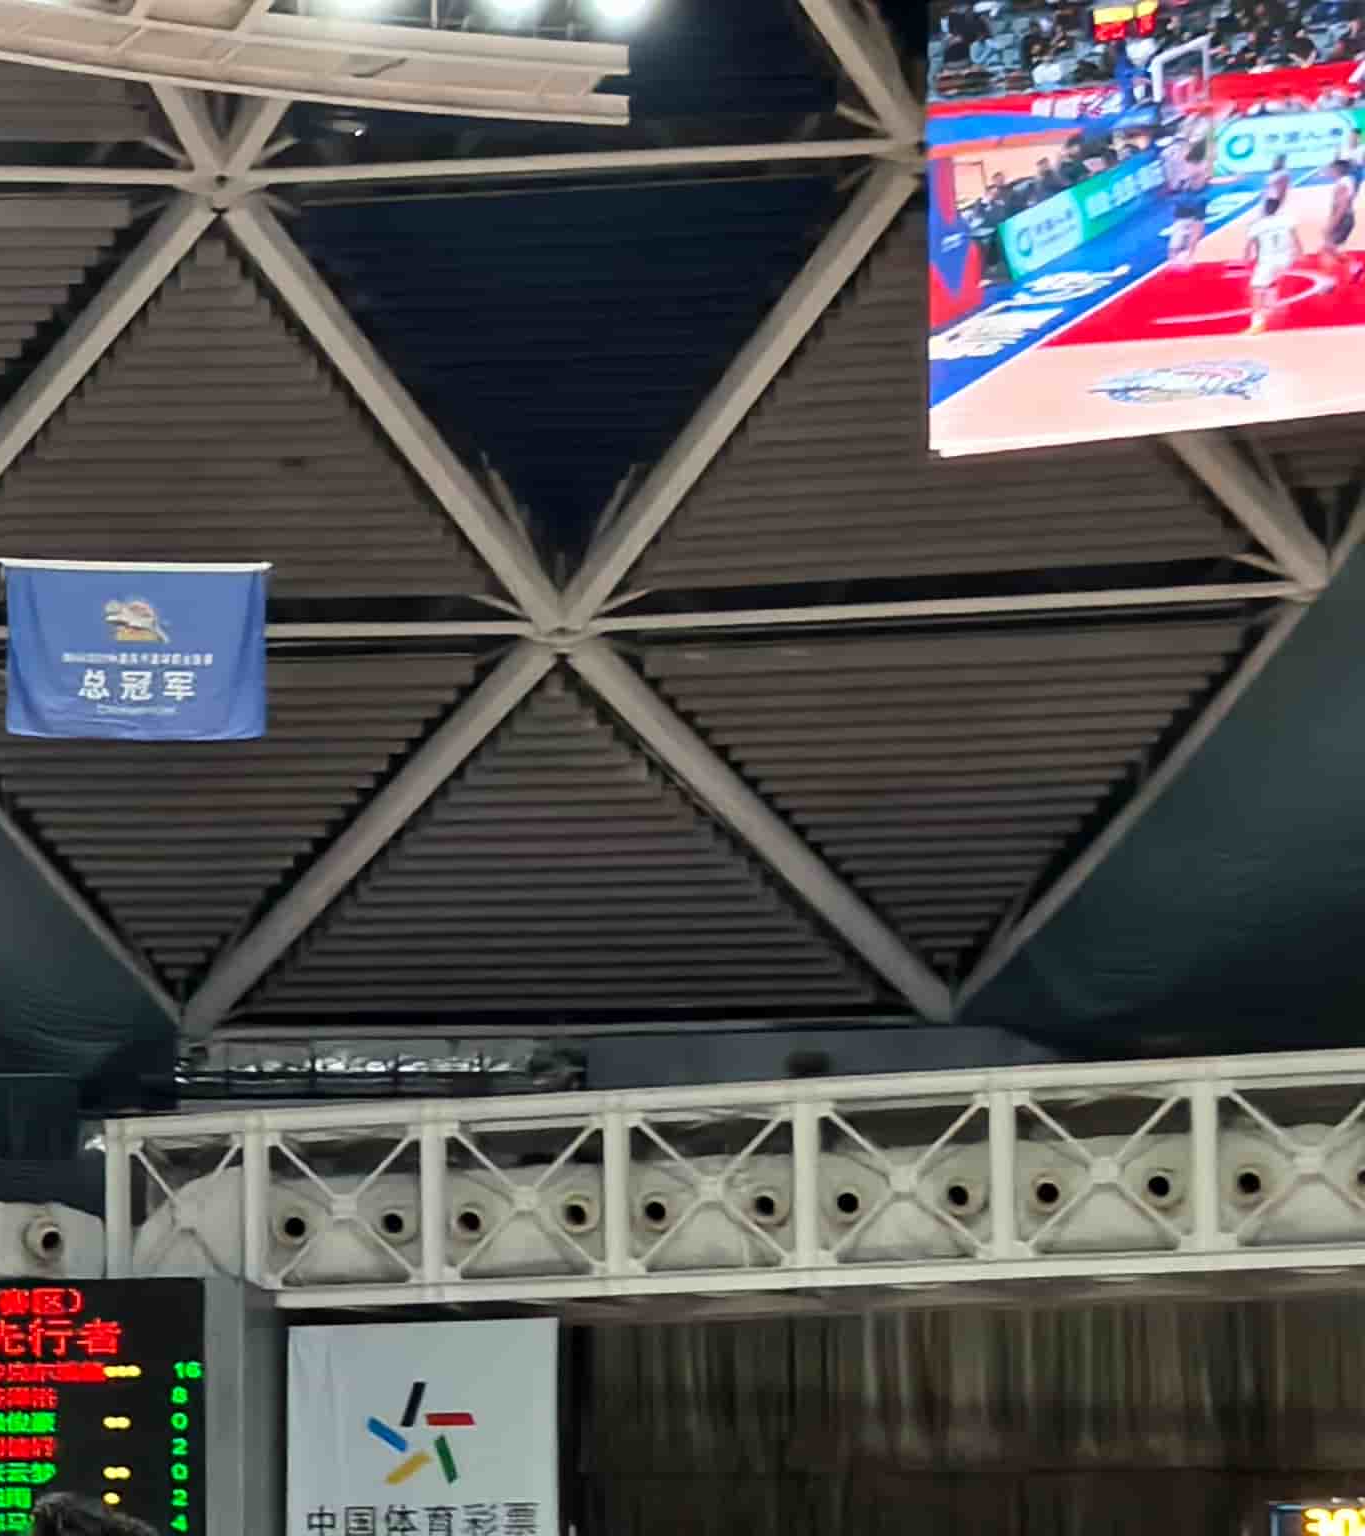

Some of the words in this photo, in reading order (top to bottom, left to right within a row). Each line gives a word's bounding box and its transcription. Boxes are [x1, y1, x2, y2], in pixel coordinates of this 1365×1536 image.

[77, 668, 197, 701] 总冠军
[171, 1412, 188, 1430] 0
[172, 1438, 188, 1456] 2
[171, 1463, 188, 1482] 0
[172, 1489, 189, 1507] 2
